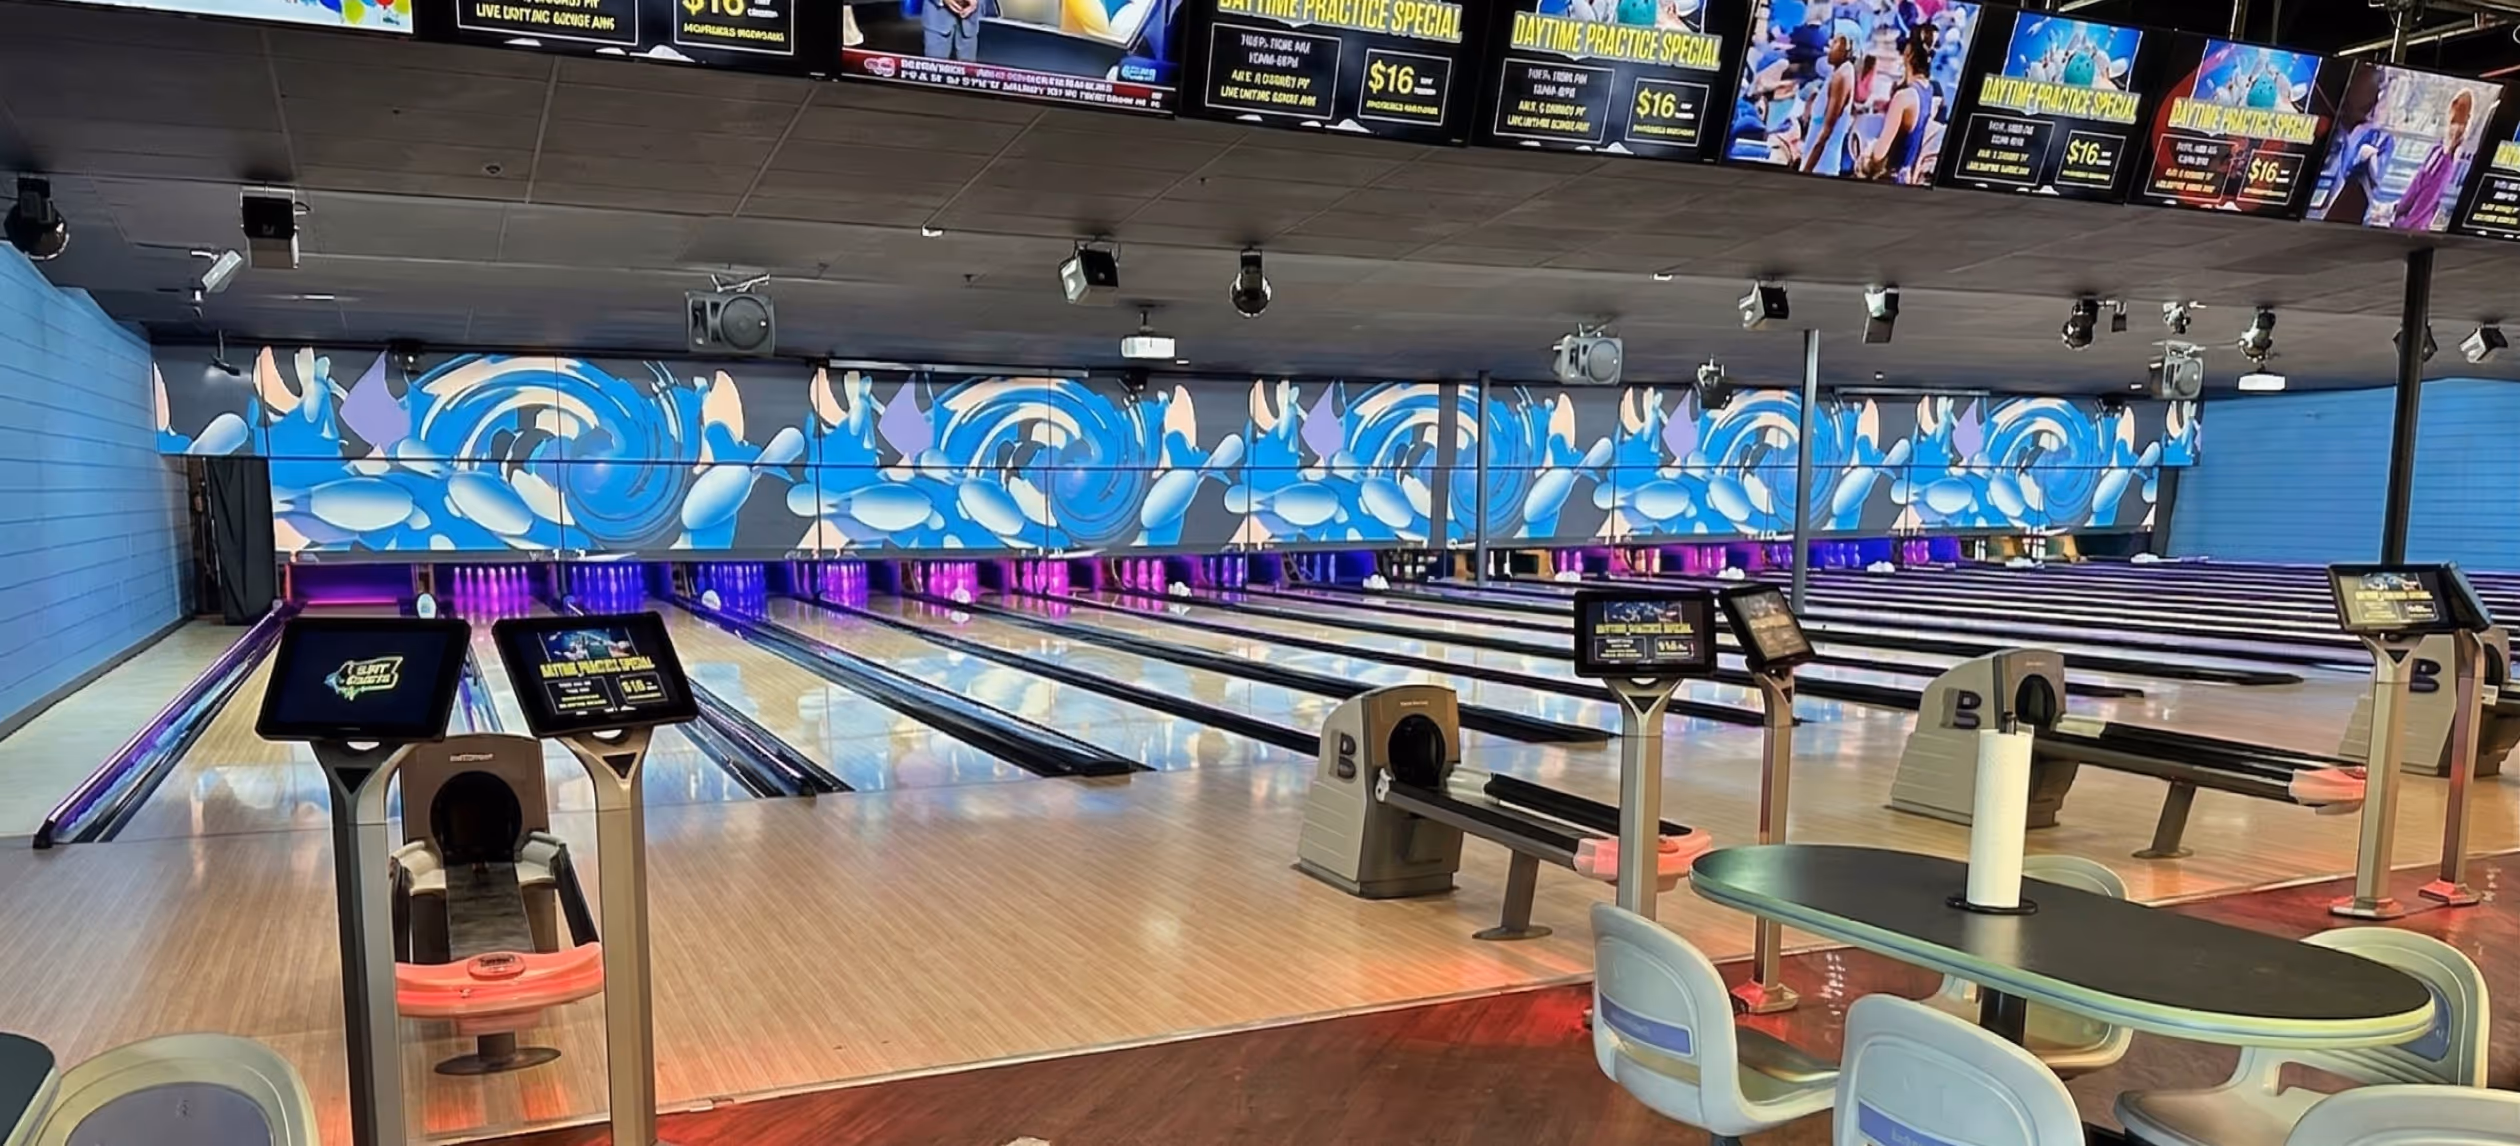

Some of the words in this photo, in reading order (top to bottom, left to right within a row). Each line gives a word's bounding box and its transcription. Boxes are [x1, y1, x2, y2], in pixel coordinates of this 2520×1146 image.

[1303, 0, 1387, 29] PRACTICE
[1391, 1, 1462, 40] SPECIAL
[1513, 15, 1583, 53] DAYTIME
[1585, 23, 1659, 60] PRACTICE
[1660, 32, 1721, 66] SPECIAL
[1368, 59, 1415, 95] $16
[1636, 87, 1677, 119] $16
[1980, 77, 2037, 109] DAYTIME
[2035, 82, 2091, 116] PRACTICE
[2090, 91, 2138, 121] SPECIAL
[2066, 138, 2101, 166] $16
[2248, 157, 2279, 185] $16
